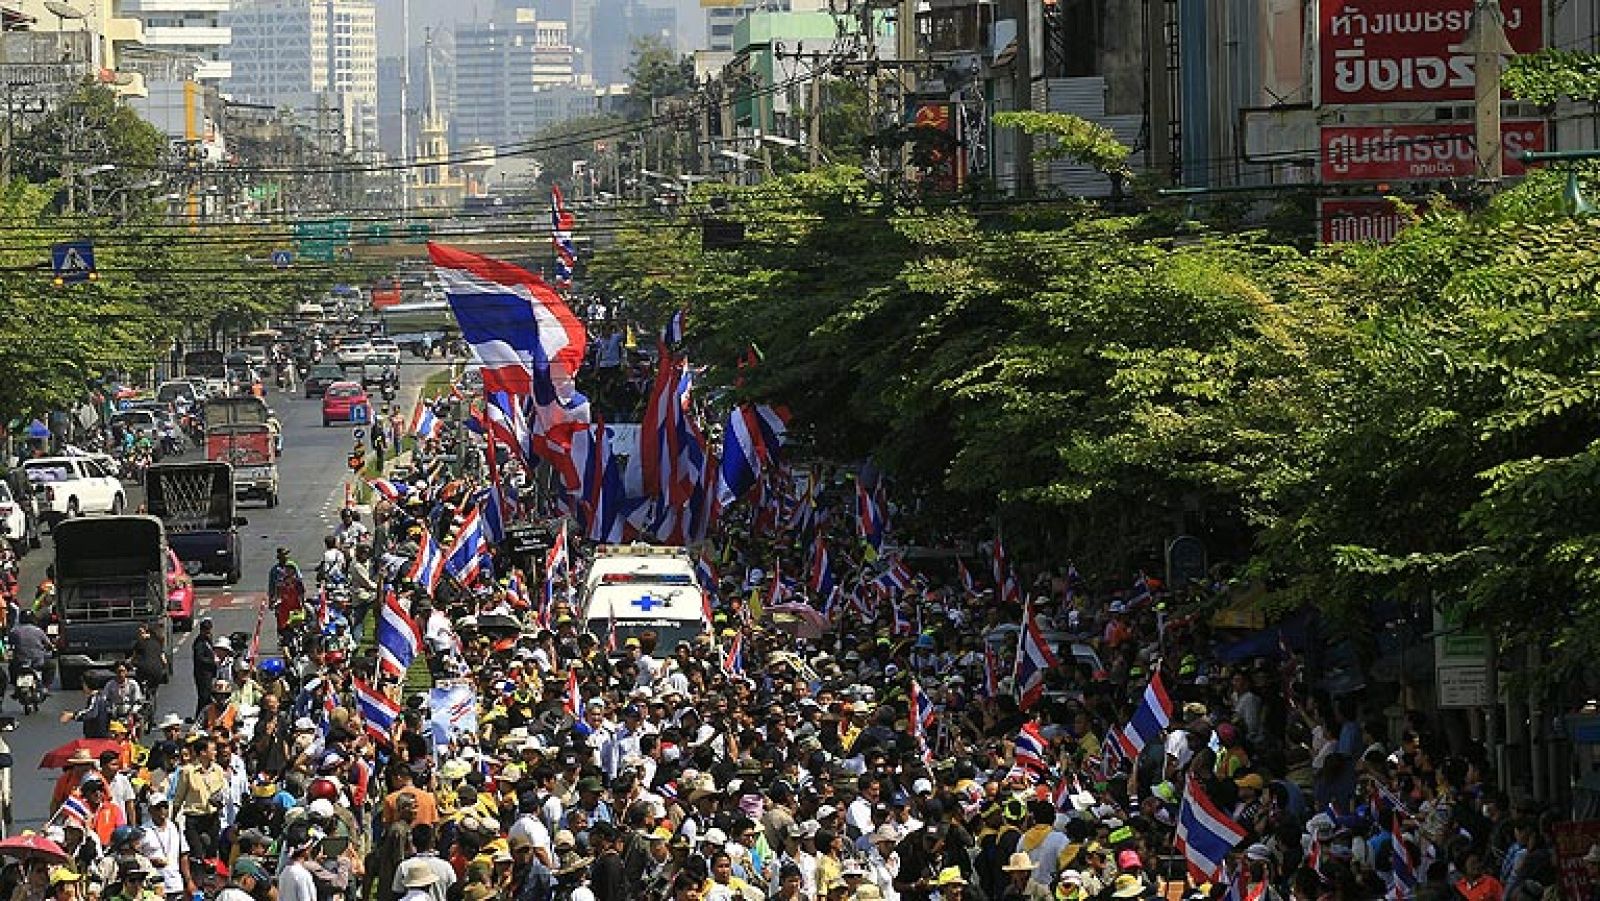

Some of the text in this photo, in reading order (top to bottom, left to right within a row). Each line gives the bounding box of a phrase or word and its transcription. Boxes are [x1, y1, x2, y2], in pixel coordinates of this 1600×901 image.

[1330, 6, 1522, 37] ห้างเพชรง
[1334, 38, 1506, 92] ยิ่งเจริ
